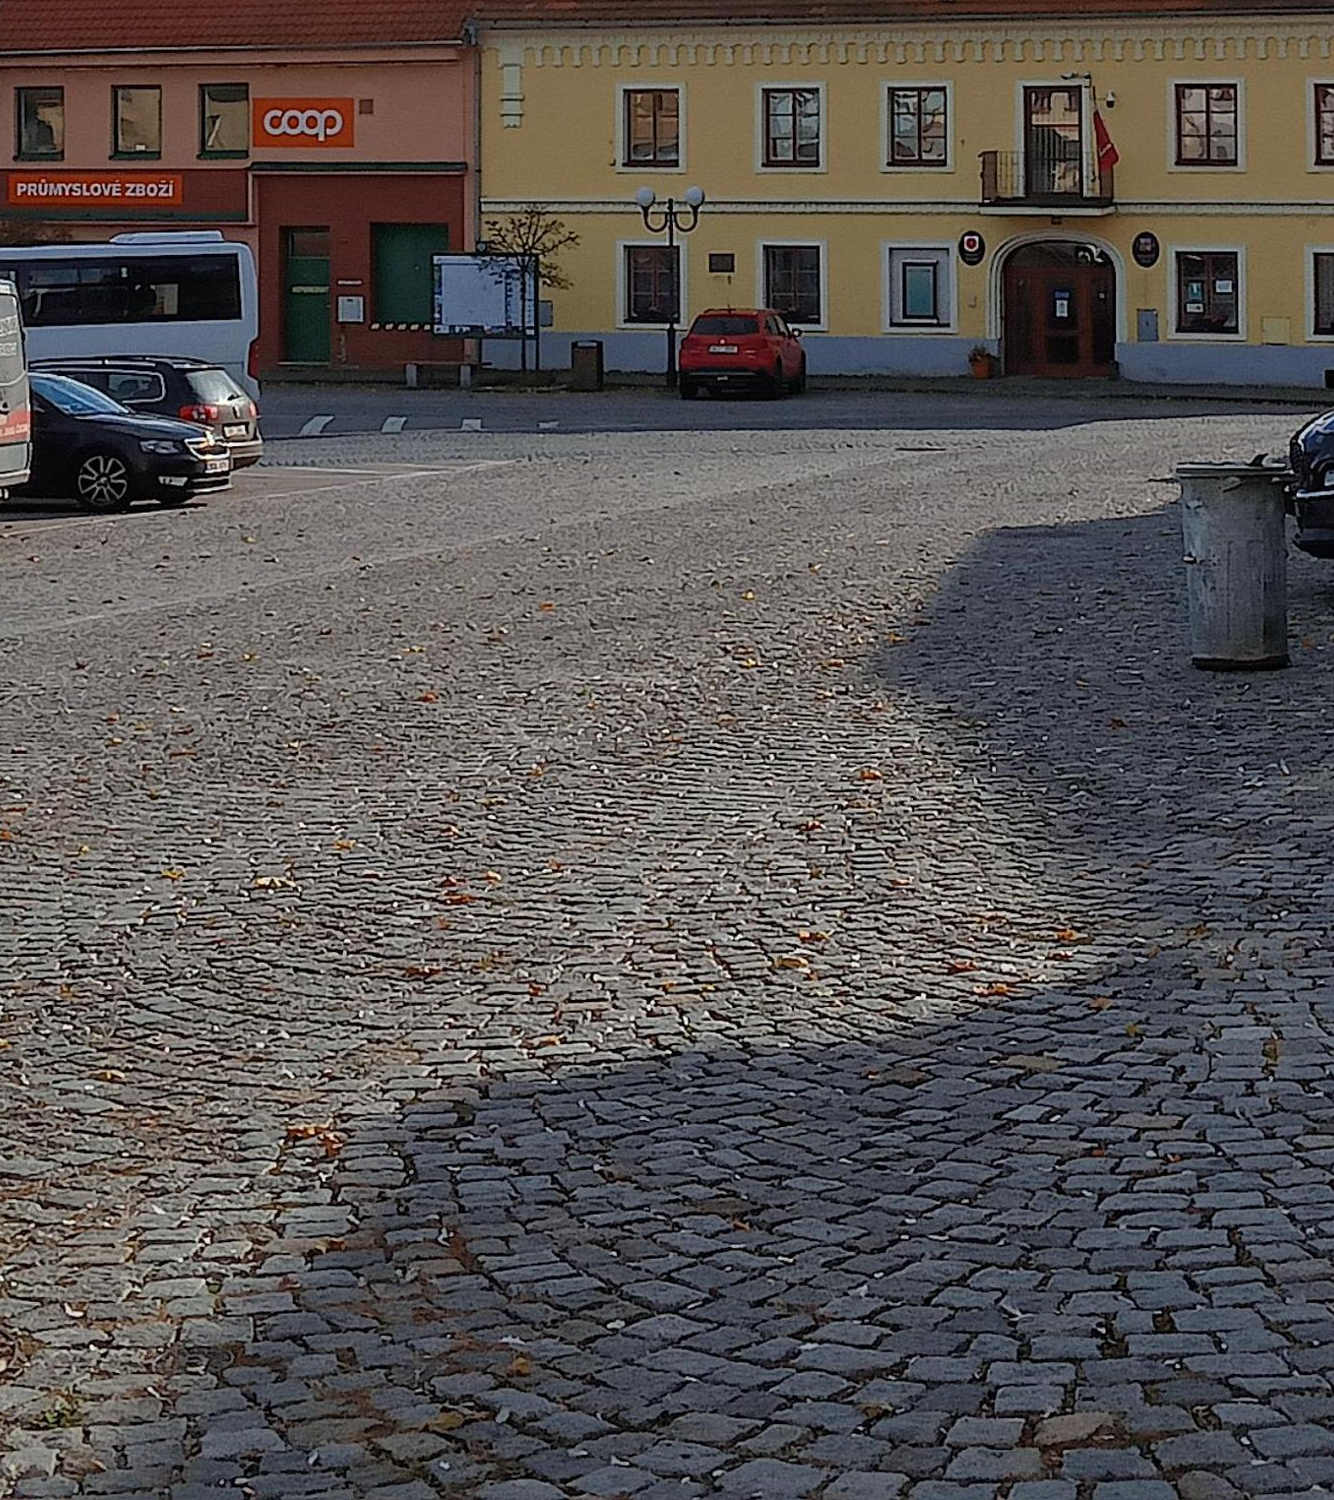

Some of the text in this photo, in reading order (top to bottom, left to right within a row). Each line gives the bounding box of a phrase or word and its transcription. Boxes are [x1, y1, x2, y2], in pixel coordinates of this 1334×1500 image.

[263, 109, 343, 141] coop
[17, 179, 175, 198] PRŮMYSLOVÉ ZBOŽÍ
